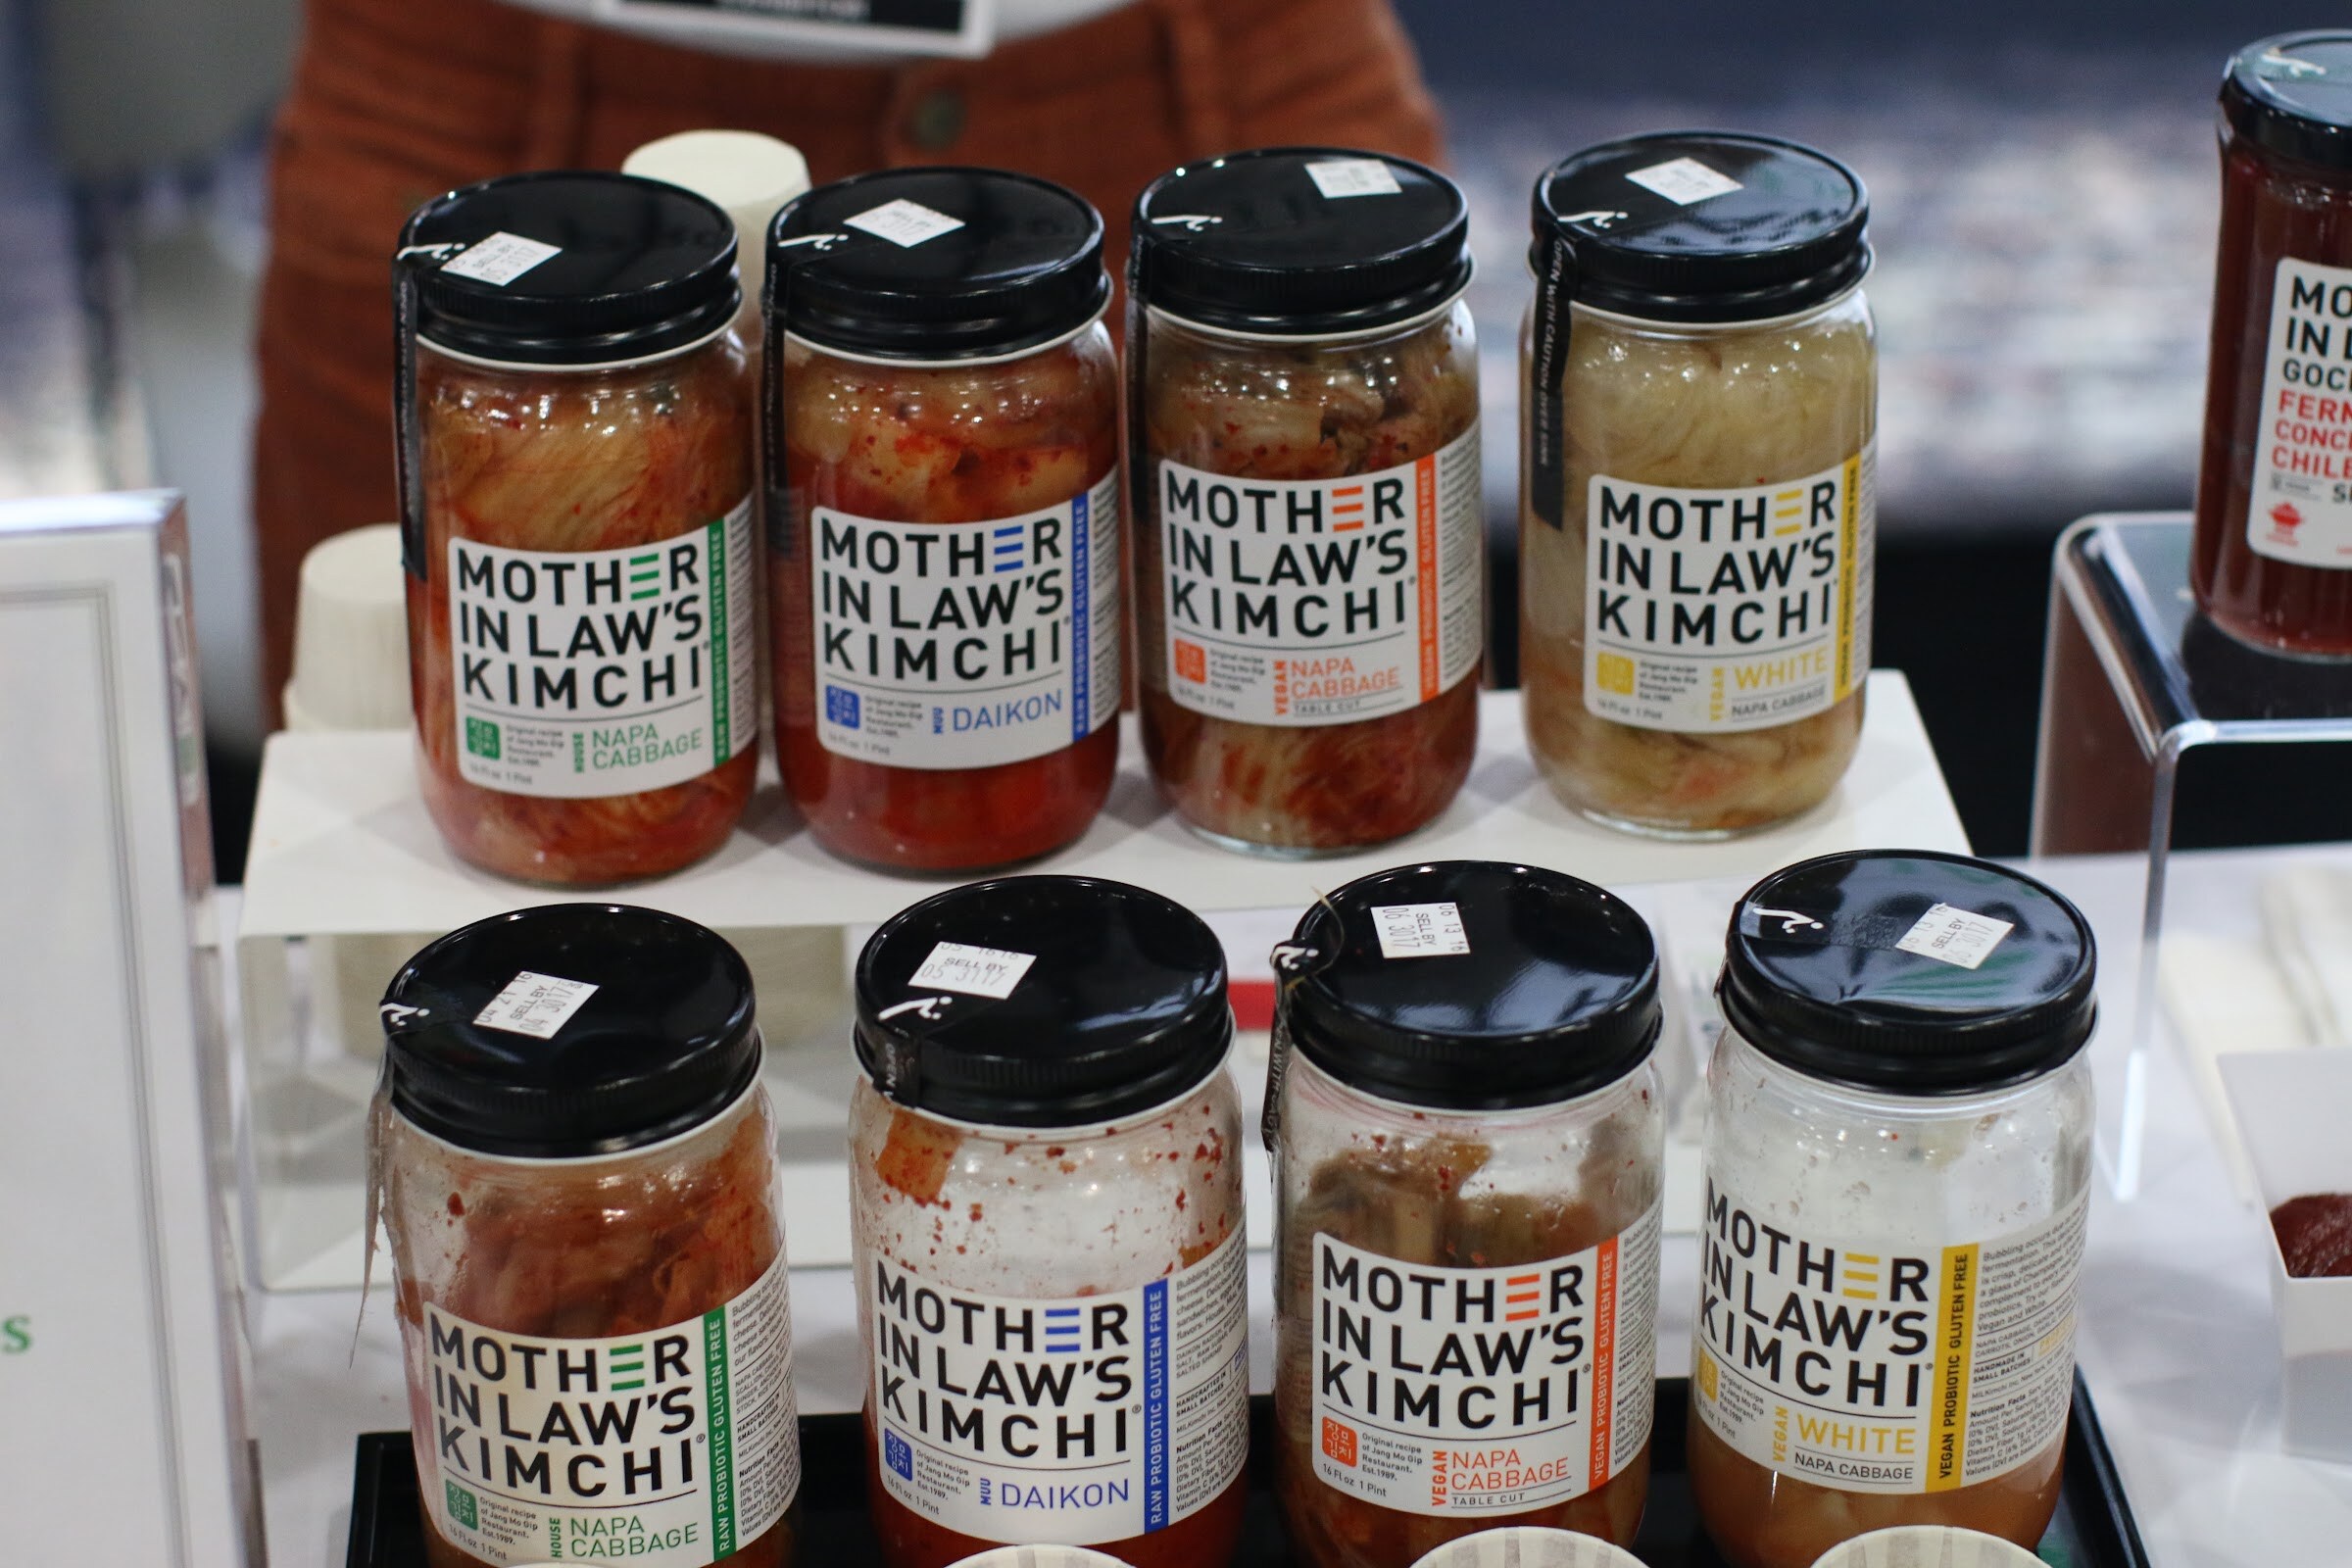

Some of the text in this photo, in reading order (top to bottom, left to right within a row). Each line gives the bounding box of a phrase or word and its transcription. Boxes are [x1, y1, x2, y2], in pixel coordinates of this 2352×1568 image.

[1550, 240, 1563, 281] OPEN
[1545, 284, 1558, 321] WITH
[1541, 323, 1556, 388] CAUTION
[2286, 317, 2330, 357] IN
[2283, 359, 2352, 391] GOC
[2276, 418, 2352, 451] CONC
[1167, 470, 1404, 534] MOTHER
[1601, 480, 1836, 542] MOTHER
[2332, 482, 2352, 503] S
[821, 517, 1061, 577] MOTHER
[1170, 523, 1407, 586] IN LAW'S
[1599, 531, 1835, 596] IN LAW'S
[458, 544, 700, 606] MOTHER
[823, 569, 1063, 630] IN LAW'S
[461, 595, 702, 659] IN LAW'S
[1292, 658, 1355, 678] NAPA
[1292, 666, 1399, 700] CABBAGE
[1735, 647, 1829, 691] WHITE
[954, 690, 1062, 731] DAIKON
[1732, 702, 1770, 717] NAPA
[592, 722, 659, 748] NAPA
[593, 729, 703, 769] CABBAGE
[1416, 912, 1437, 946] SELL BY
[1932, 918, 1966, 949] SELL BY
[944, 957, 1008, 971] SELL BY
[510, 985, 549, 1020] SELL BY
[884, 1043, 897, 1086] OPEN
[1271, 1053, 1284, 1091] WITH
[1706, 1175, 1929, 1302] MOTHER
[1323, 1244, 1584, 1323] MOTHER
[1703, 1233, 1927, 1355] IN LAW'S
[877, 1259, 1129, 1352] MOTHER
[430, 1311, 690, 1393] MOTHER
[1323, 1298, 1584, 1377] IN LAW'S
[879, 1312, 1132, 1406] IN LAW'S
[1593, 1251, 1614, 1479] VEGAN PROBIOTIC GLUTEN FREE
[1939, 1254, 1968, 1479] VEGAN PROBIOTIC GLUTEN FREE
[1973, 1371, 1998, 1383] SMALL
[435, 1364, 695, 1446] IN LAW'S
[1151, 1291, 1161, 1525] RAW PROBIOTIC GLUTEN FREE
[1970, 1394, 2026, 1418] Nutrition Facts
[710, 1318, 733, 1553] RAW PROBIOTIC GLUTEN FREE
[1362, 1433, 1422, 1453] Original recipe
[1773, 1406, 1788, 1462] VEGAN
[1796, 1414, 1916, 1454] WHITE
[916, 1449, 969, 1475] Original recipe
[1362, 1453, 1412, 1473] Restaurant.
[1371, 1446, 1391, 1459] Jang
[1393, 1452, 1405, 1461] Mo
[1407, 1455, 1422, 1465] Gip
[1451, 1457, 1568, 1492] CABBAGE
[1452, 1449, 1521, 1469] NAPA
[1794, 1452, 1913, 1480] NAPA CABBAGE
[887, 1475, 894, 1488] 16
[904, 1490, 912, 1500] oz
[922, 1499, 940, 1515] Pint
[925, 1463, 941, 1478] Jang
[944, 1472, 955, 1482] Mo
[956, 1476, 970, 1488] Gip
[980, 1478, 992, 1505] MUU
[1002, 1478, 1129, 1510] DAIKON
[1323, 1463, 1332, 1476] 16
[1345, 1476, 1354, 1486] oz
[1359, 1481, 1363, 1490] 1
[1367, 1483, 1387, 1497] Pint
[1432, 1450, 1447, 1506] VEGAN
[479, 1496, 536, 1520] Original recipe
[1452, 1492, 1524, 1506] TABLE CUT
[490, 1511, 508, 1525] Jang
[510, 1517, 521, 1527] Mo
[551, 1516, 563, 1558] HOUSE
[571, 1515, 645, 1537] NAPA
[488, 1545, 508, 1560] Pint
[571, 1522, 699, 1558] CABBAGE
